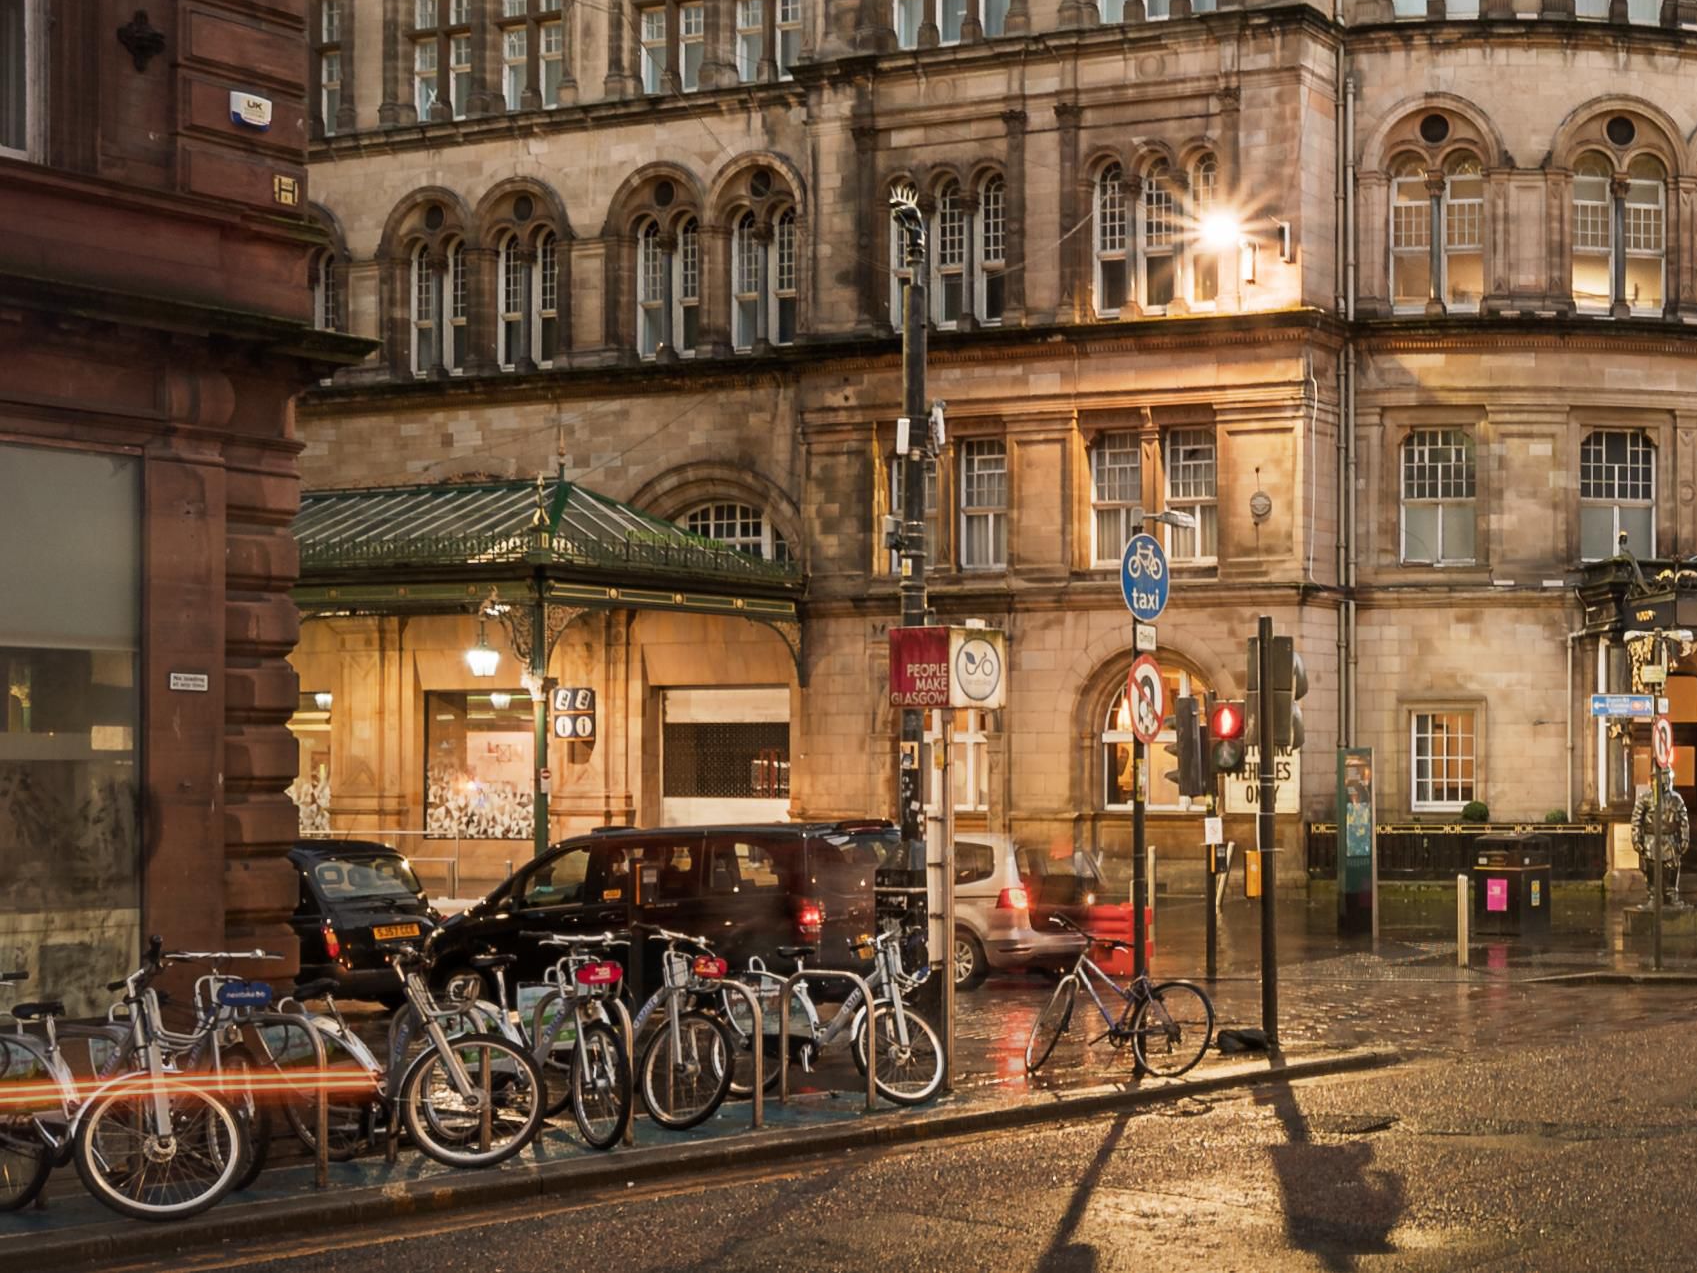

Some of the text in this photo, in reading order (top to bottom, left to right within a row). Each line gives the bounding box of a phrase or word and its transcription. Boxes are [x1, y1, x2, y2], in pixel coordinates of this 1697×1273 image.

[247, 100, 262, 110] UK
[1132, 588, 1159, 610] taxi
[907, 663, 947, 677] PEOPLE
[915, 678, 947, 691] MAKE
[891, 692, 947, 705] GLASGOW
